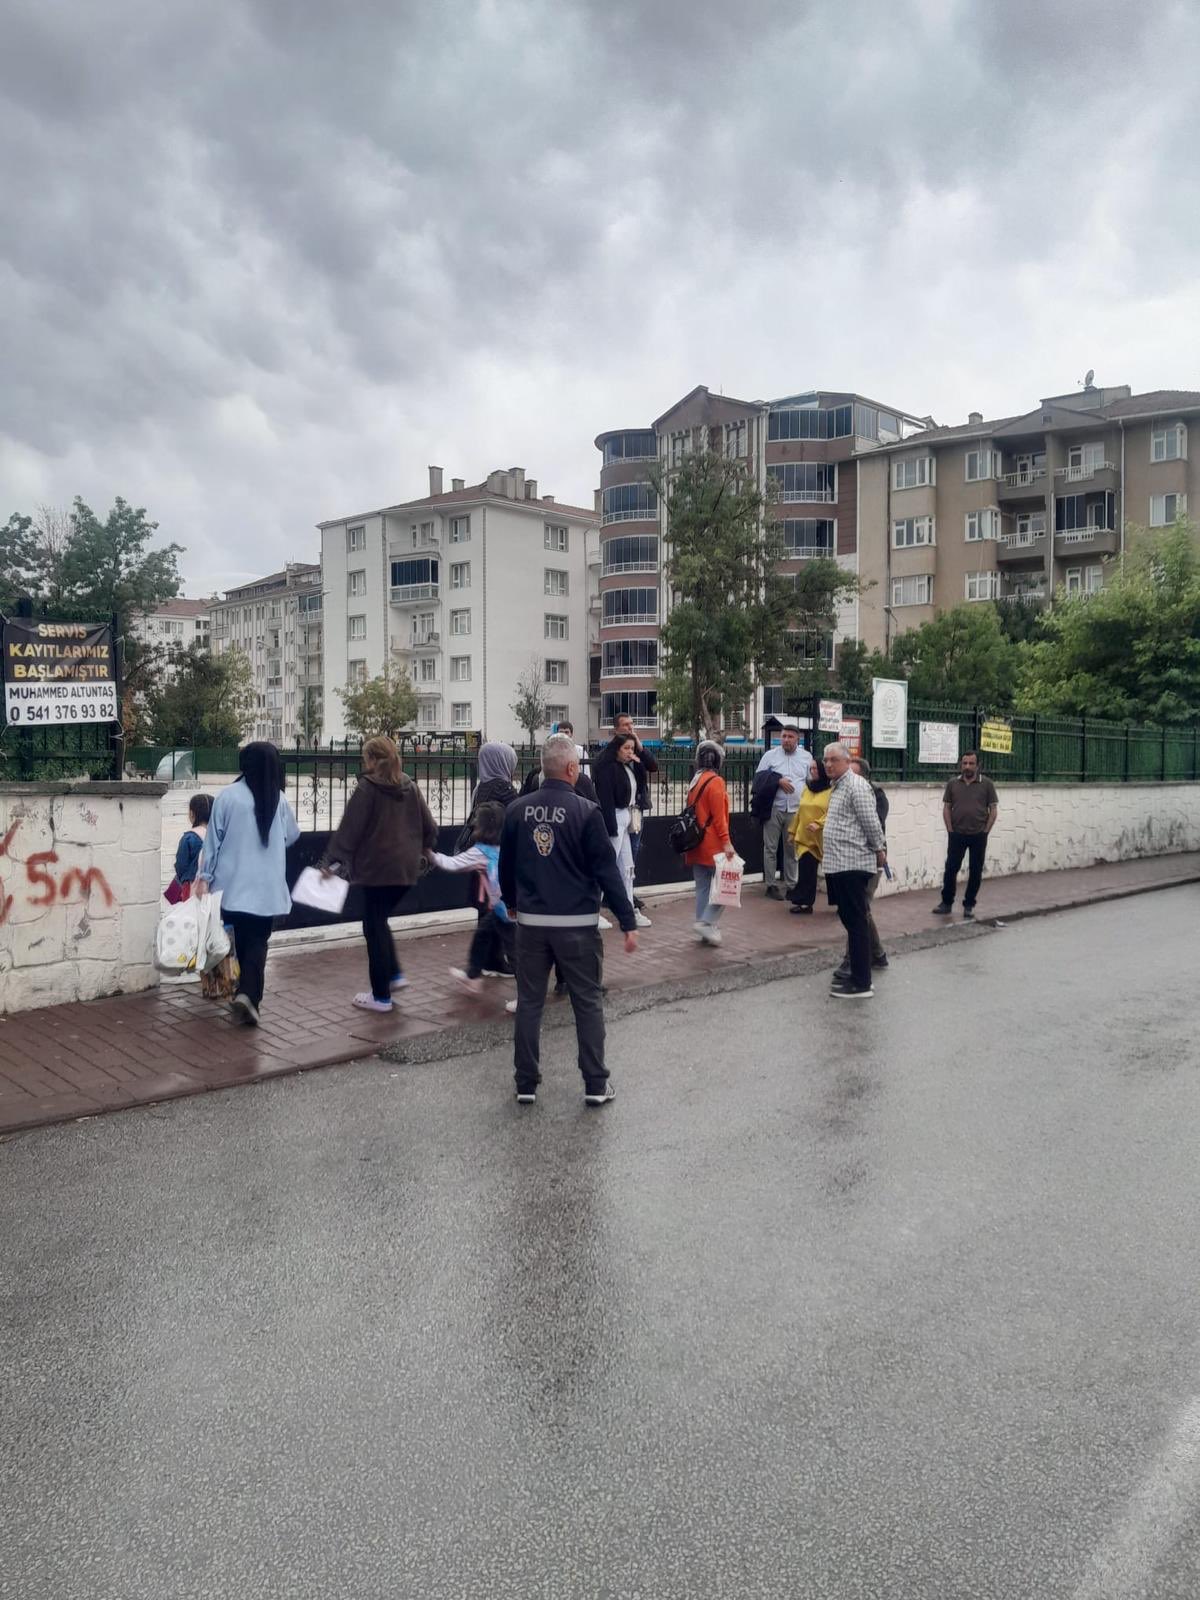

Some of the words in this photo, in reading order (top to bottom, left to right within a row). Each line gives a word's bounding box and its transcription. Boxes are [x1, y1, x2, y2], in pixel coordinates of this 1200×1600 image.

[9, 643, 110, 659] KAYITLARIMIZ
[13, 664, 109, 682] BAŞLAMIŞTIR
[9, 687, 69, 700] MUHAMMED
[71, 686, 114, 700] ALTUNTAŞ
[10, 706, 20, 721] 0
[27, 705, 50, 720] 541
[55, 705, 78, 719] 376
[81, 704, 96, 718] 93
[100, 704, 114, 717] 82
[524, 806, 566, 823] POLIS
